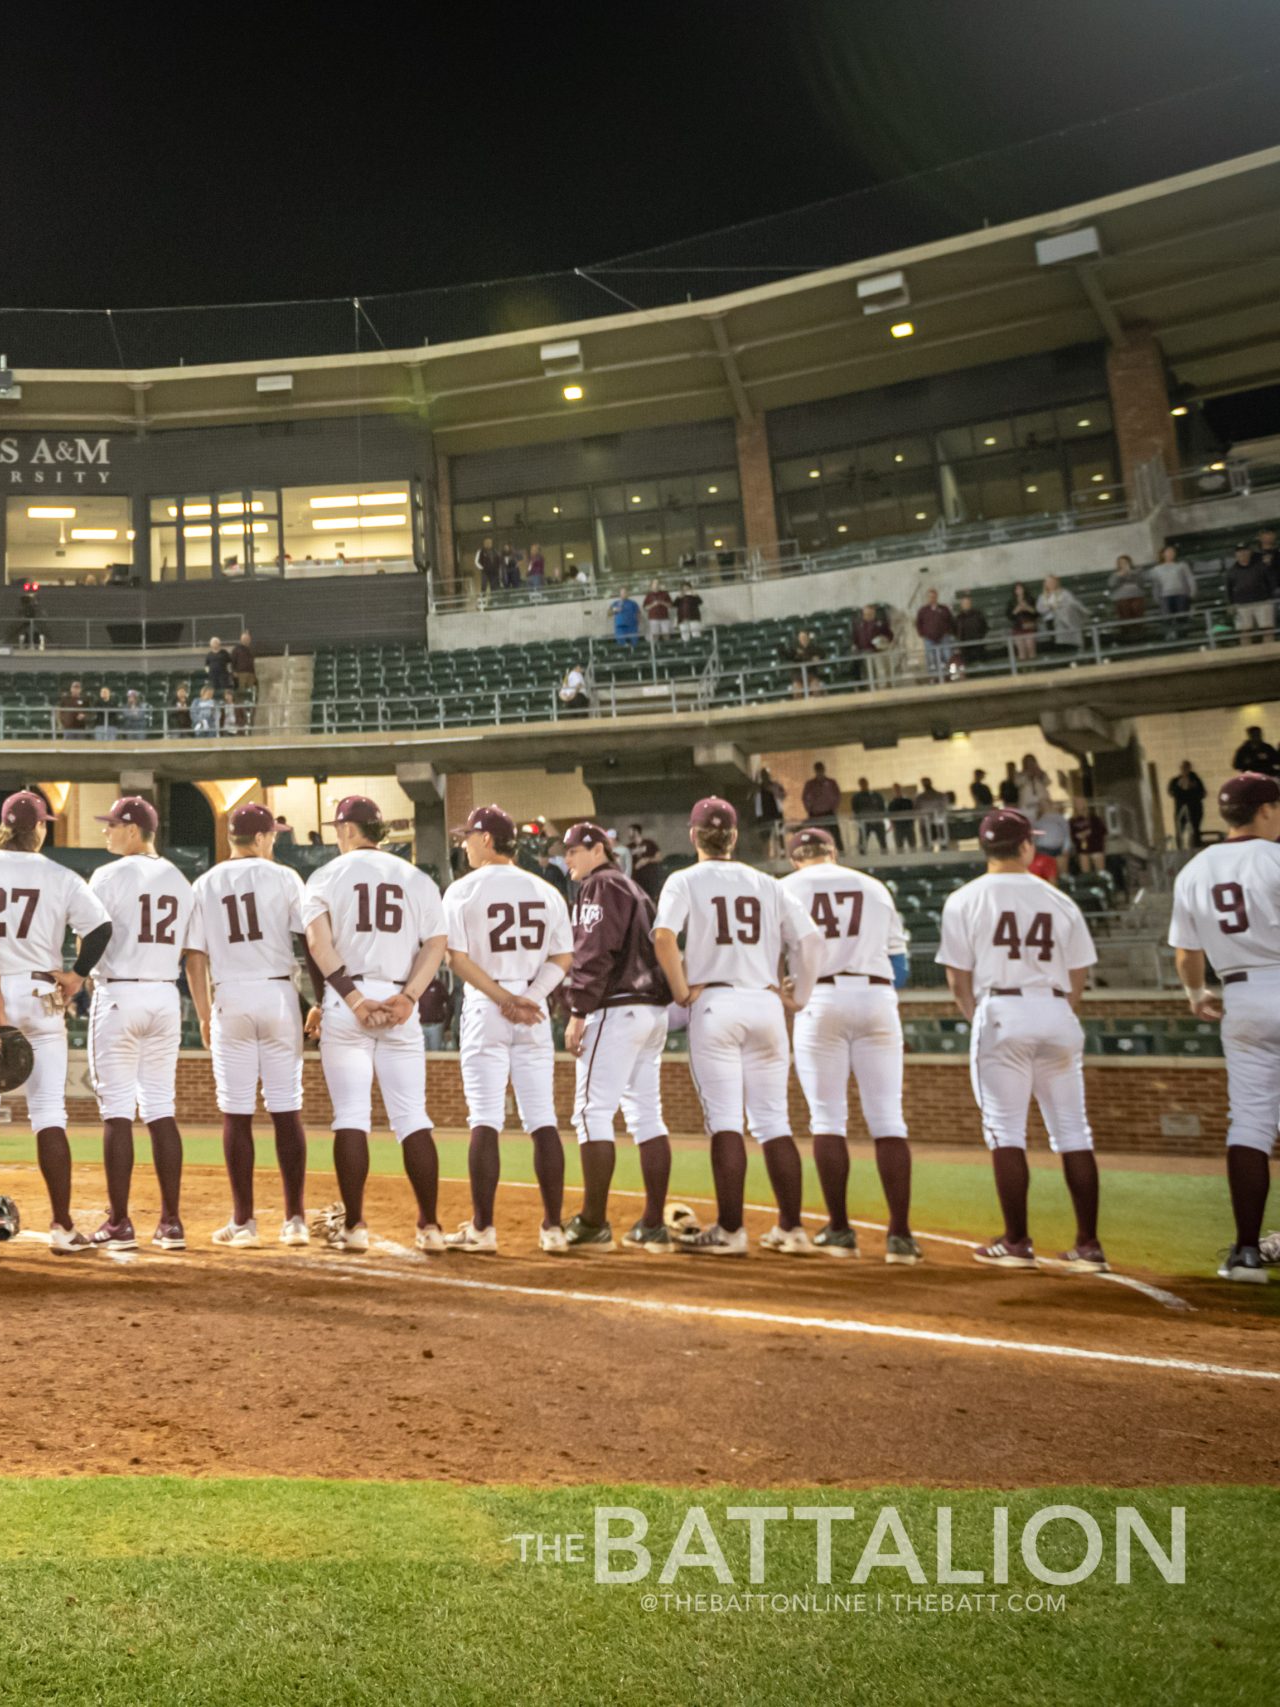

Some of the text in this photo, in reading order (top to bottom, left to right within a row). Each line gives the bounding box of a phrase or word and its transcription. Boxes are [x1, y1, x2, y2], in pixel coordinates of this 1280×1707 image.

[29, 437, 111, 464] A&M
[138, 894, 178, 945] 12
[221, 892, 263, 944] 11
[353, 882, 404, 934] 16
[487, 901, 546, 953] 25
[711, 896, 761, 945] 19
[810, 891, 864, 940] 47
[1211, 882, 1249, 935] 9
[992, 911, 1055, 962] 44
